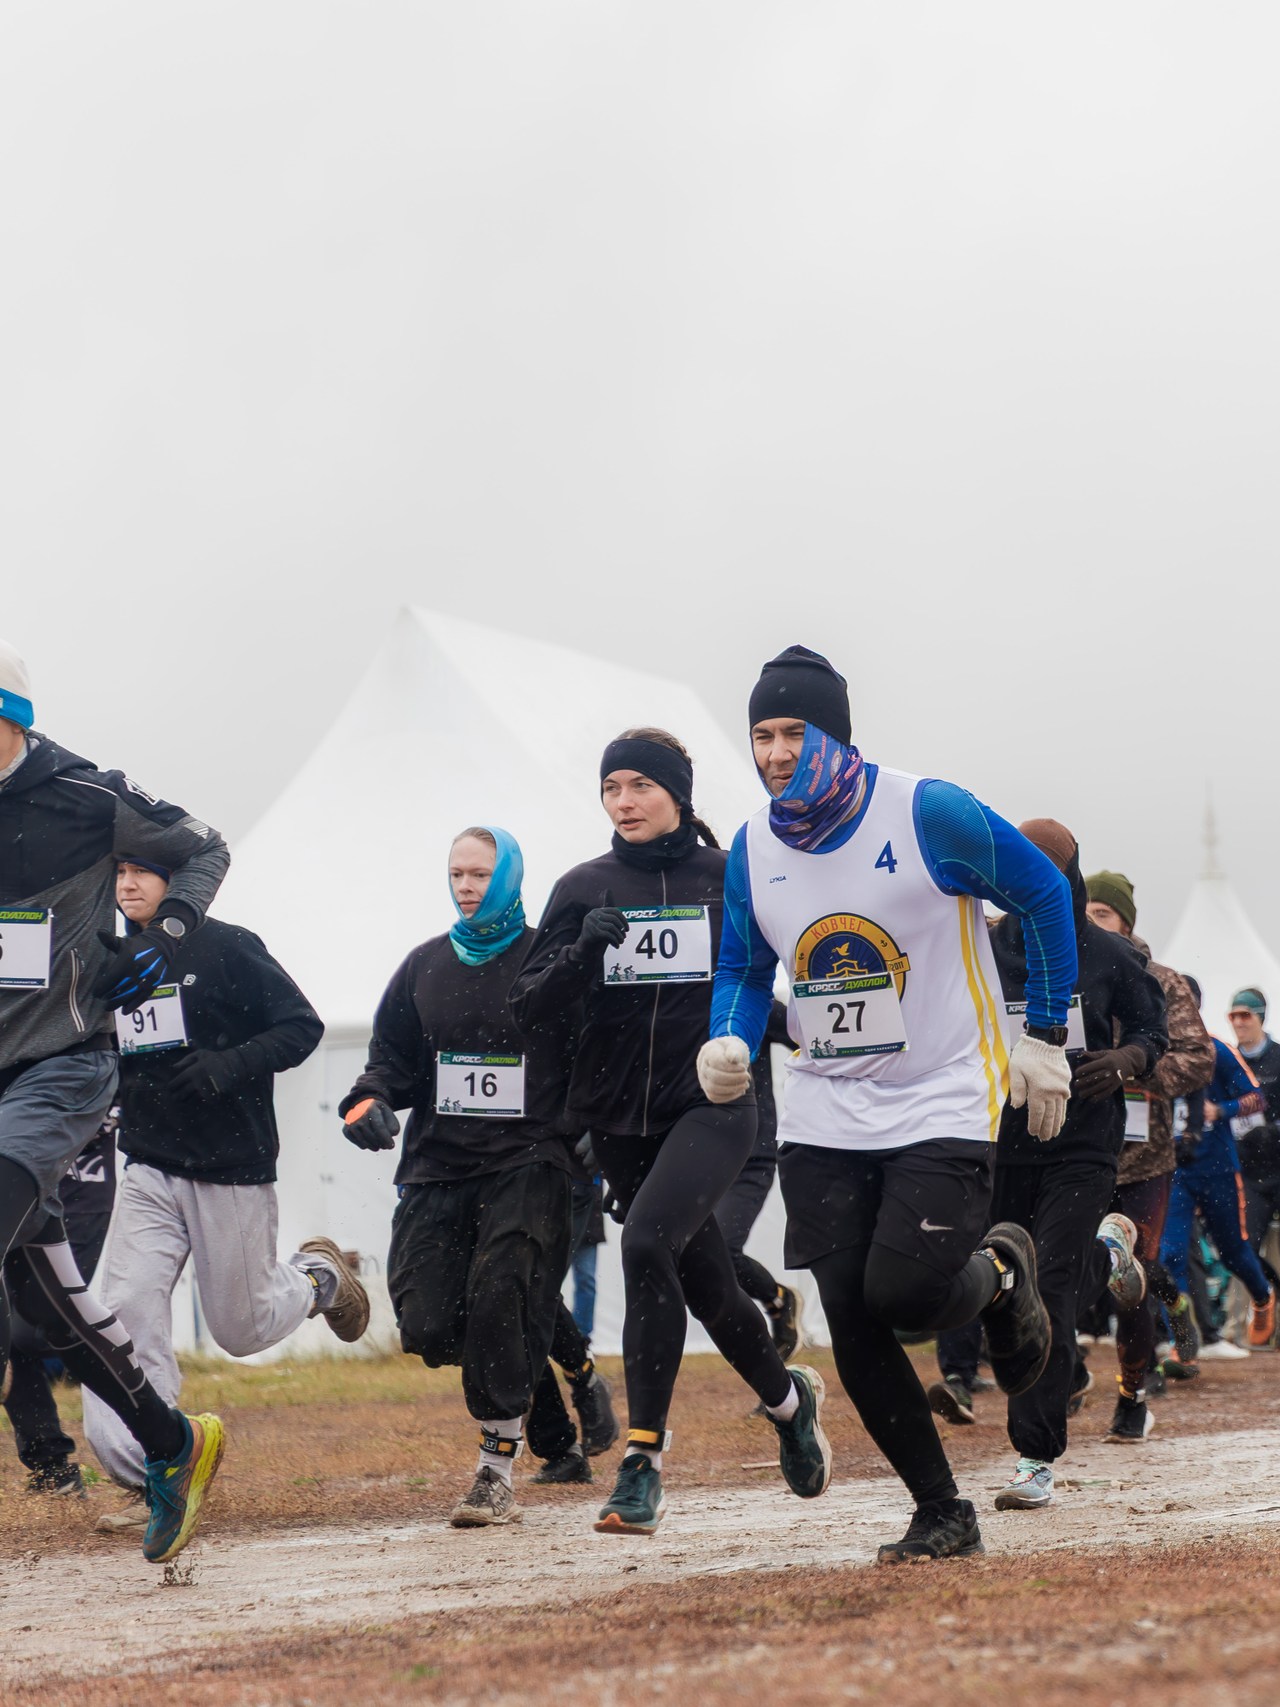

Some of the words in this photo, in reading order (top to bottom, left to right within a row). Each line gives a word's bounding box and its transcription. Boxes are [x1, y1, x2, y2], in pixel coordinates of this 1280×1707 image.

[874, 839, 898, 874] 4
[660, 908, 700, 918] ДУАТЛОН
[810, 916, 865, 940] КОВЧЕГ
[635, 928, 678, 960] 40
[808, 982, 844, 994] КРОСС
[844, 976, 887, 990] ДУАТЛОН
[132, 1006, 157, 1034] 91
[827, 1000, 866, 1034] 27
[452, 1055, 482, 1063] КРОСС
[483, 1056, 519, 1064] ДУАТЛОН
[464, 1071, 498, 1098] 16
[486, 1440, 495, 1448] LT
